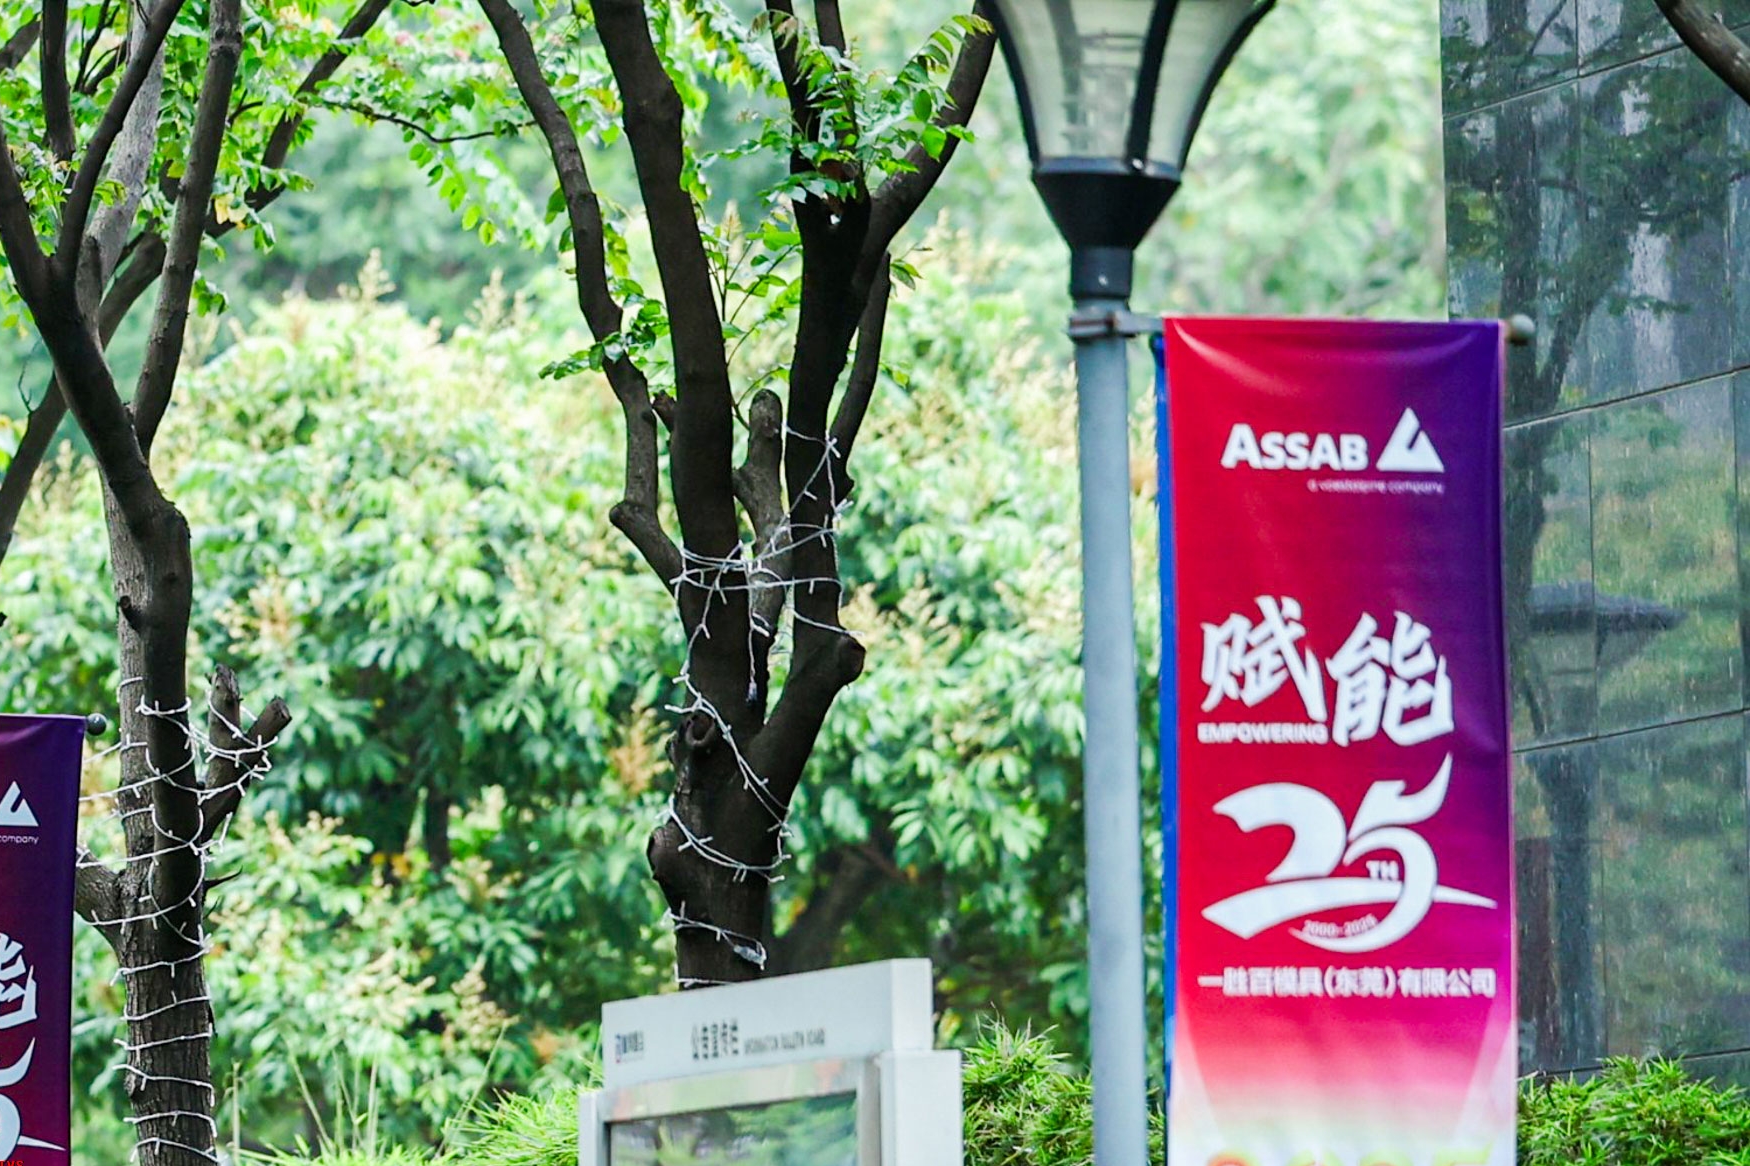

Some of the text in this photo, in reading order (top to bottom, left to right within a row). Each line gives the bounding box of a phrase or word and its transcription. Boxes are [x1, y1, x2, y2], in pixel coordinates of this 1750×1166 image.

[1221, 423, 1369, 471] ASSAB
[1199, 595, 1454, 747] 赋能
[1197, 722, 1328, 744] EMPOWERING
